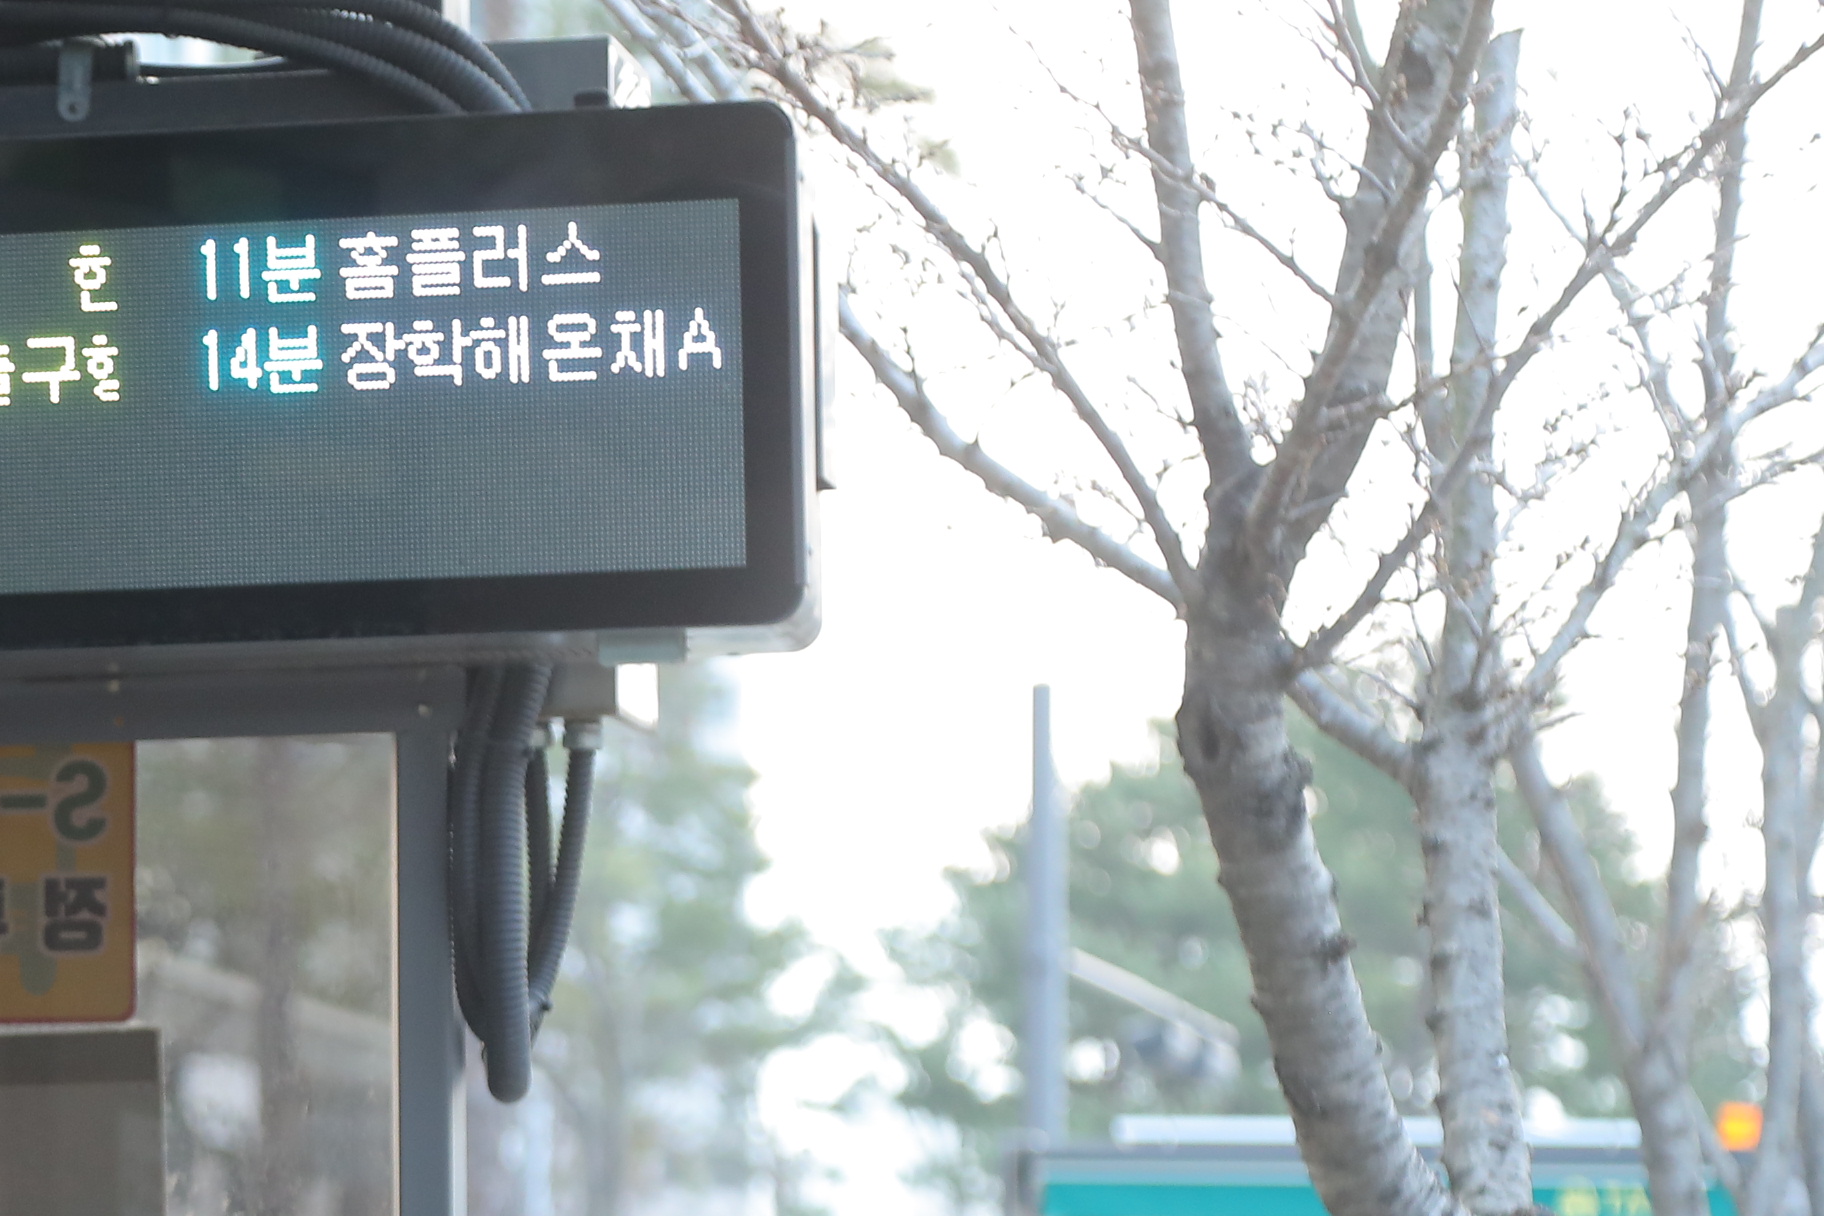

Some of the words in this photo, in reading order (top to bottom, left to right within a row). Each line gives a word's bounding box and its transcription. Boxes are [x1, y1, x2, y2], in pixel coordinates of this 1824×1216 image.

[199, 233, 322, 304] 11분
[338, 220, 602, 301] 홈플러스
[201, 324, 324, 394] 14분
[339, 306, 723, 391] 장학해온채A
